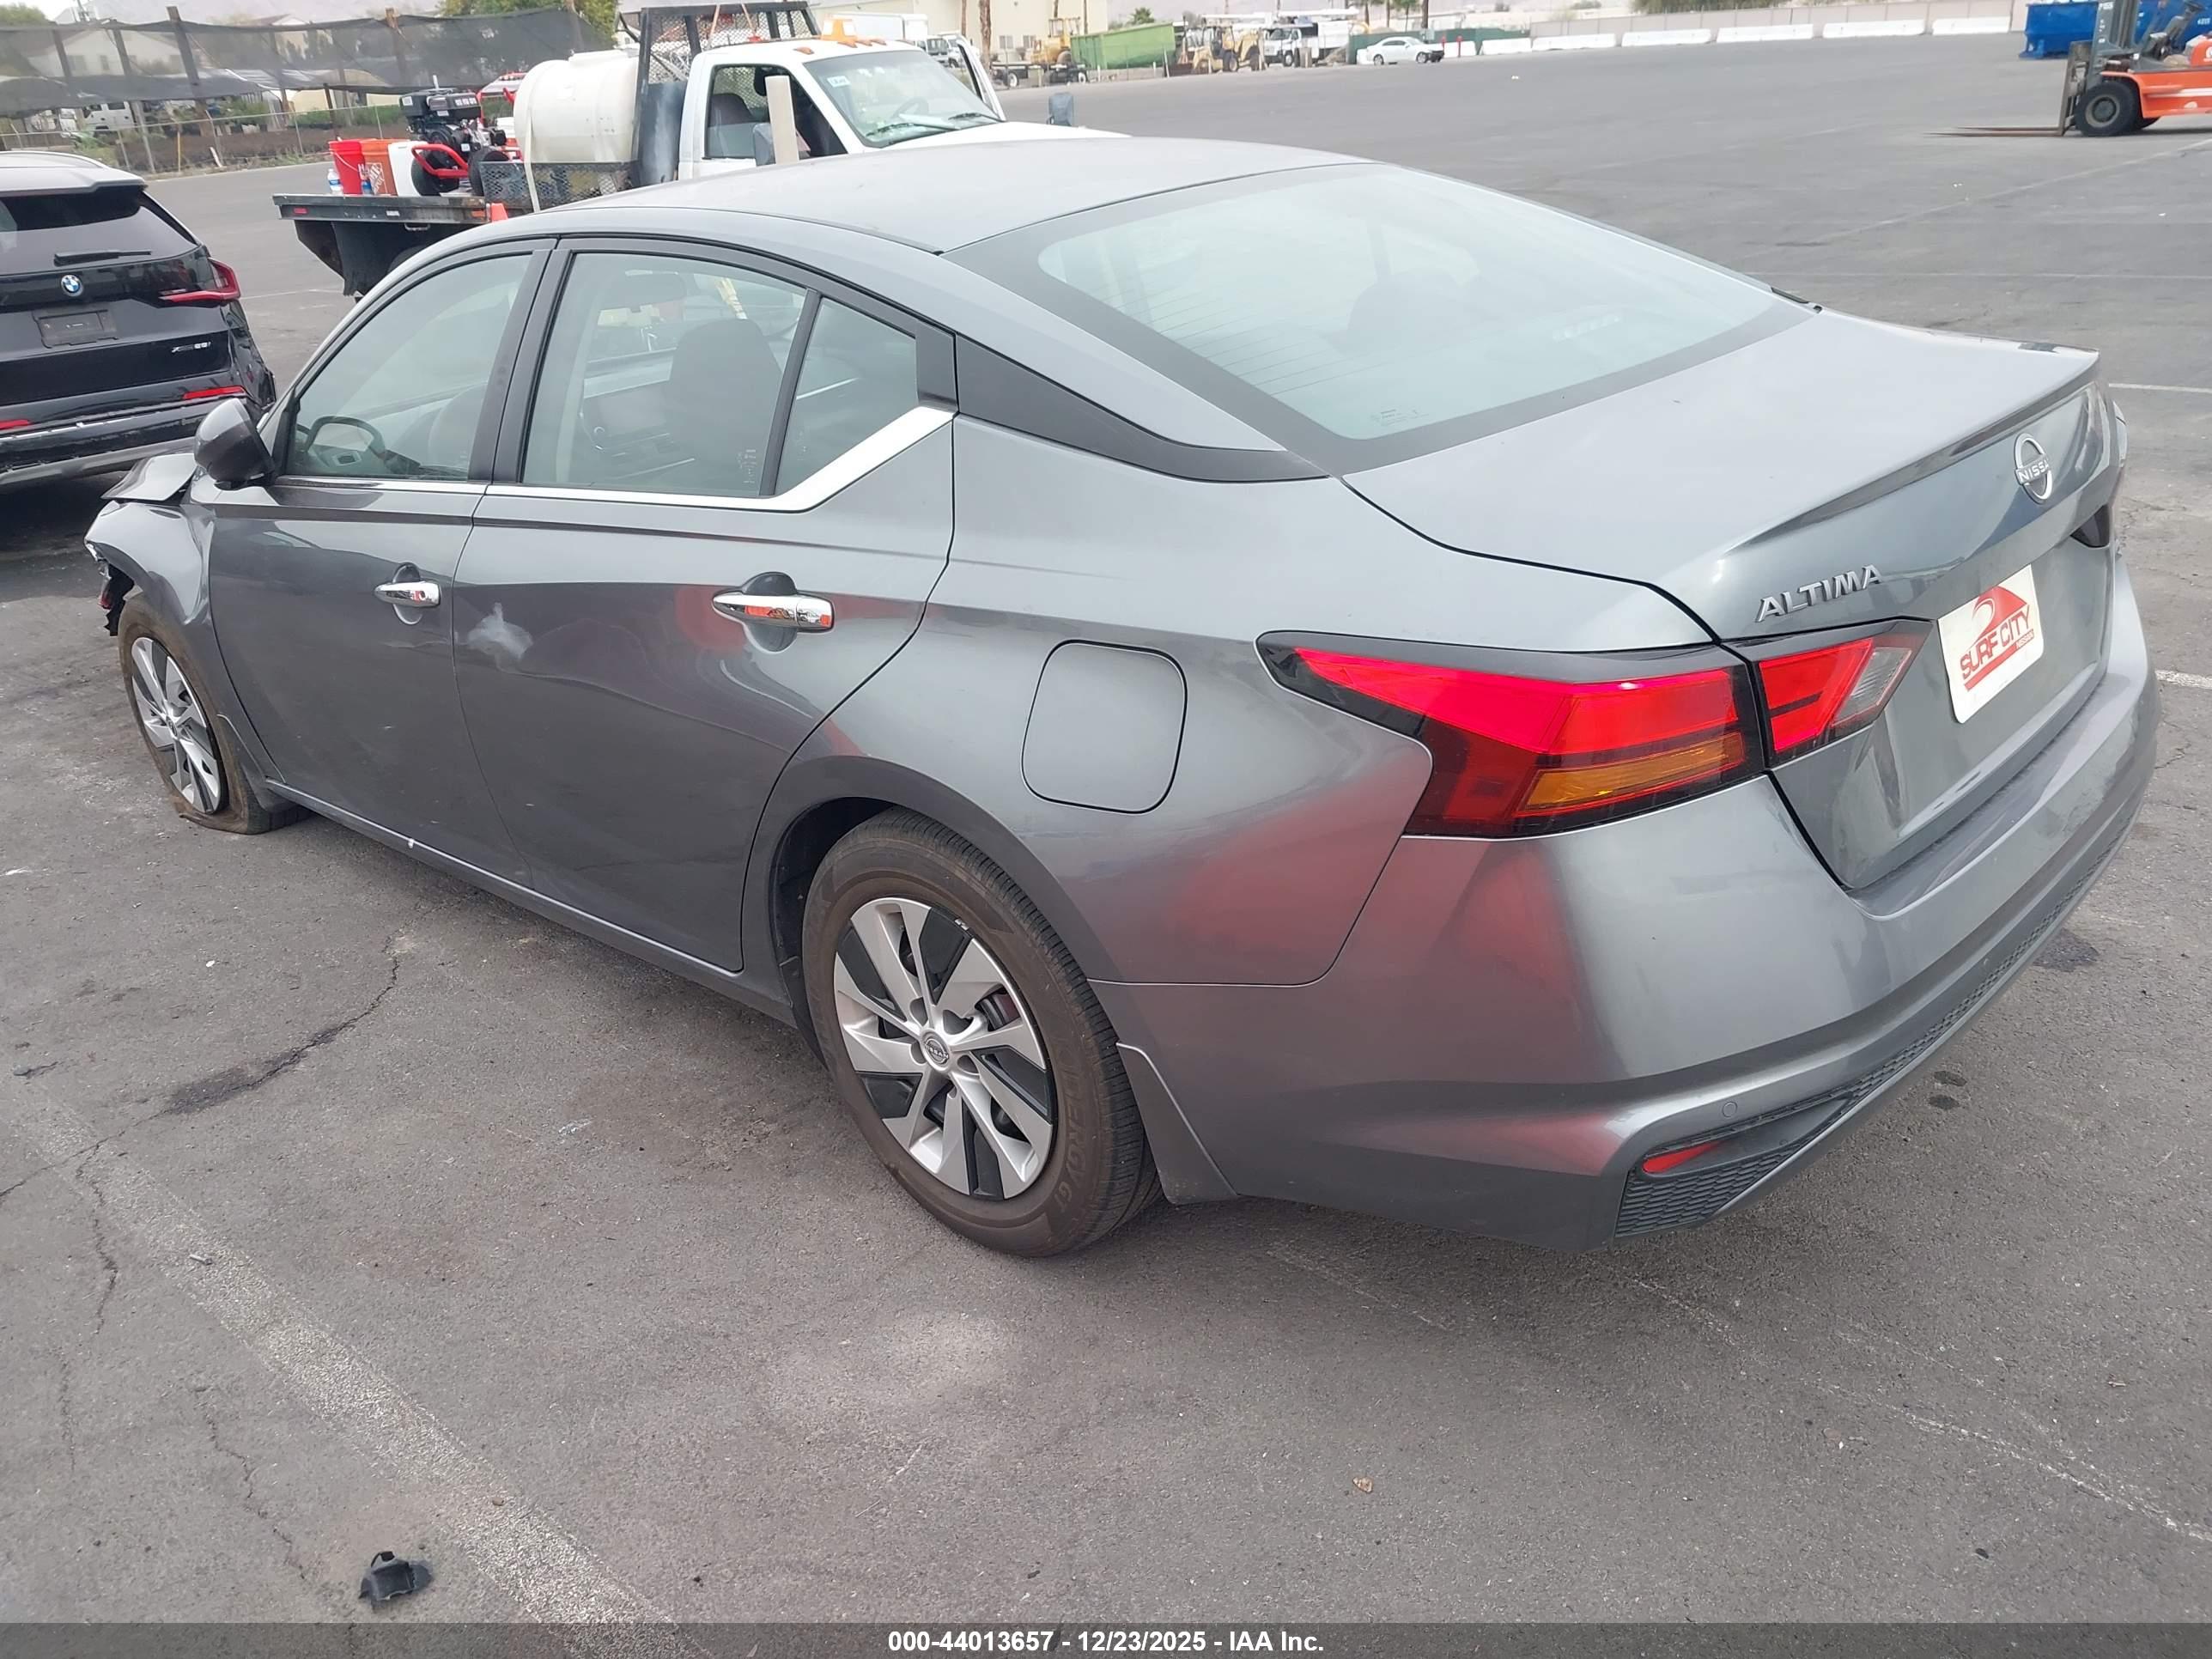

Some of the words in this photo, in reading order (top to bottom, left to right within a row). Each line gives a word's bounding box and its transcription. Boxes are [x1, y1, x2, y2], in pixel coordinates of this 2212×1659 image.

[2018, 459, 2050, 483] NISSA
[1755, 563, 1882, 623] ALTIMA
[1960, 632, 1998, 680] SURF
[2000, 605, 2030, 647] CITY
